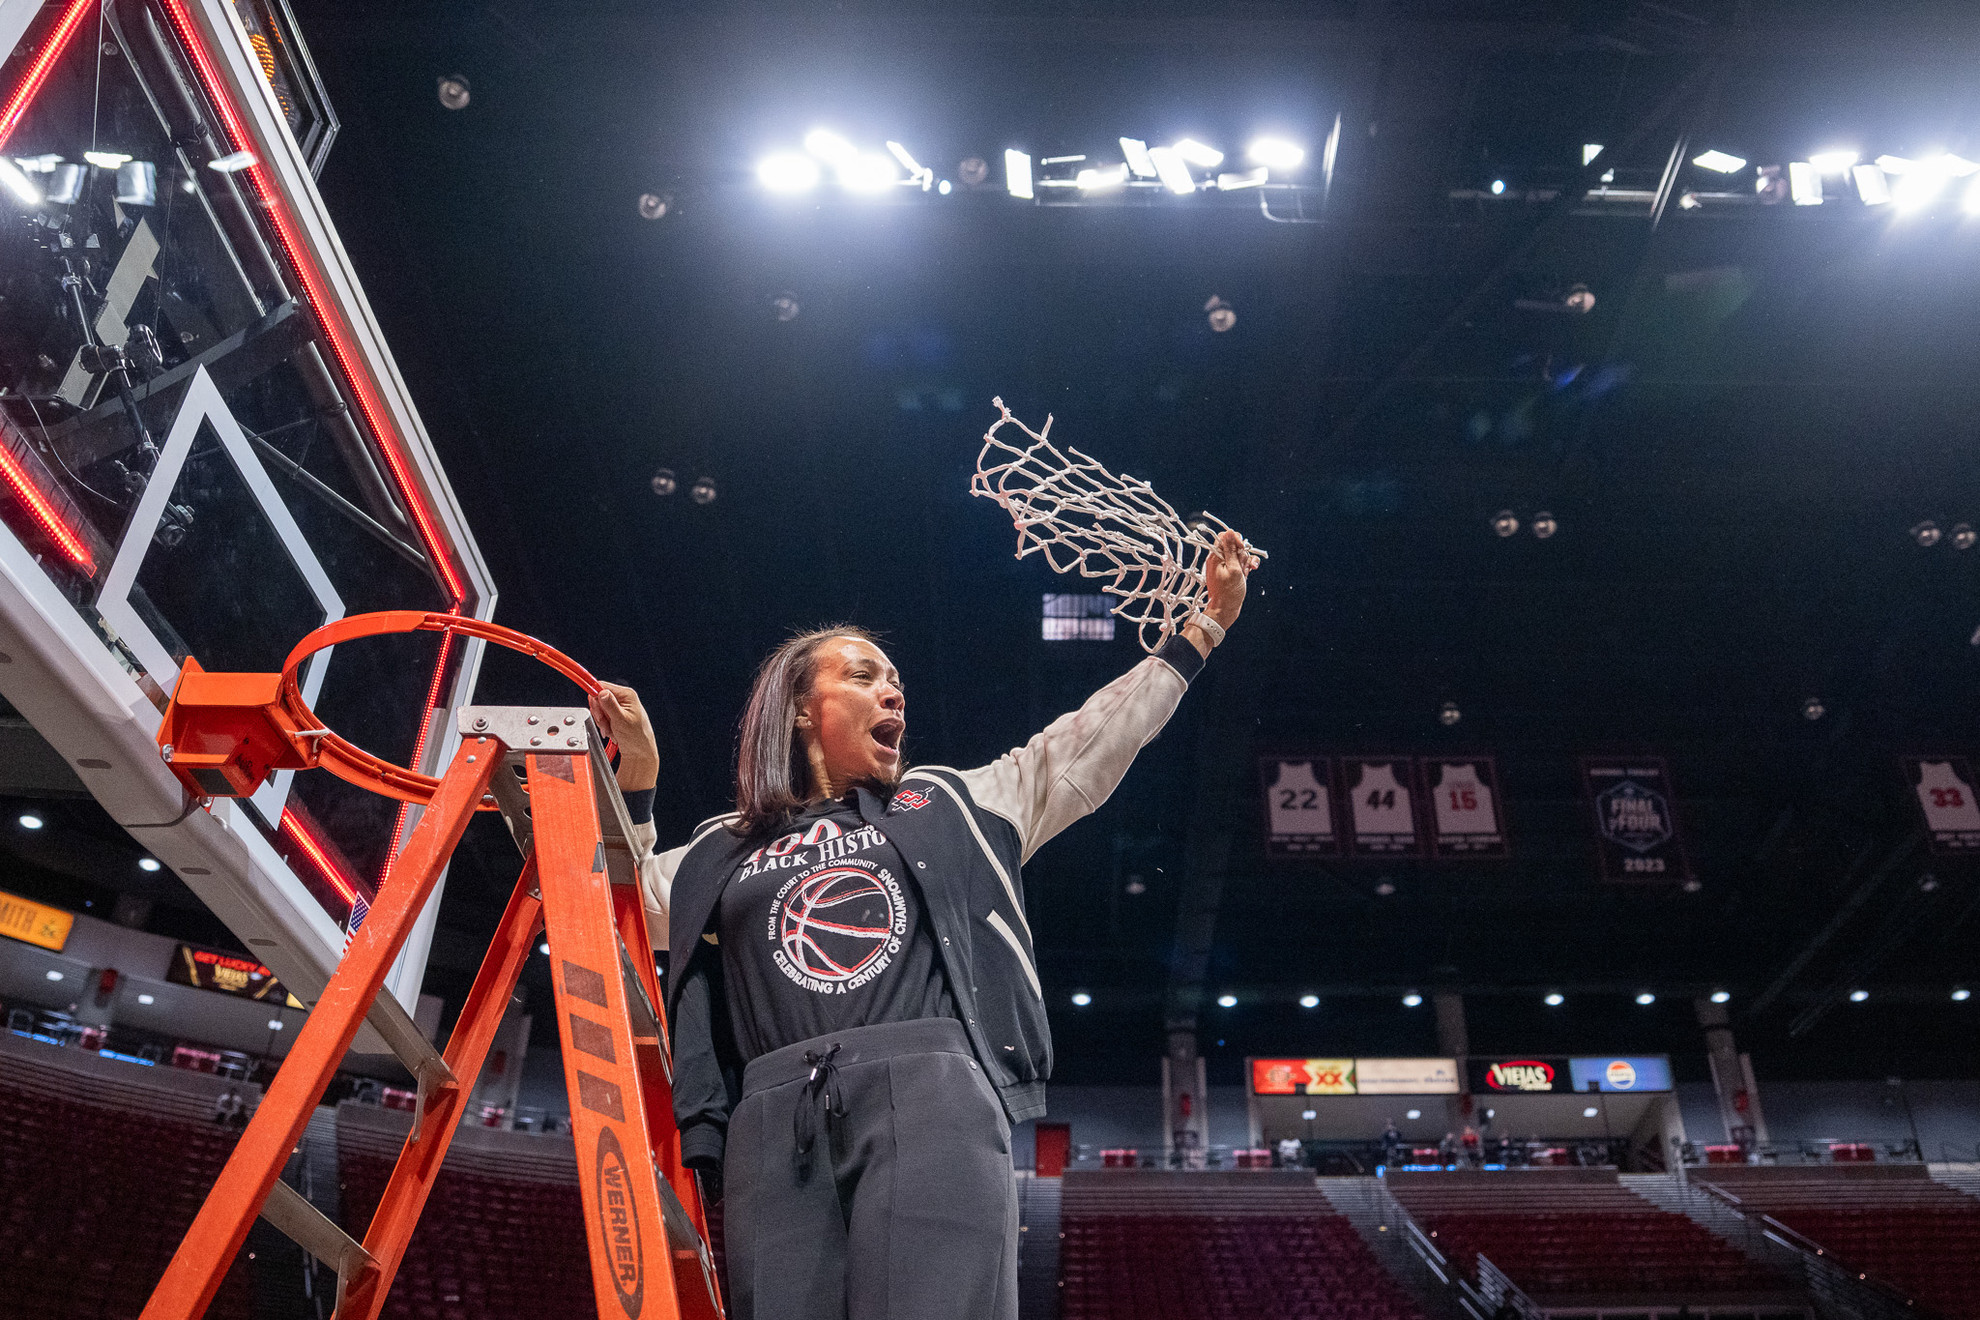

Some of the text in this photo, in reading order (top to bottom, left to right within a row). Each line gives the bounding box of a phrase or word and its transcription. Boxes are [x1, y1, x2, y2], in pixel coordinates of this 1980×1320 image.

[1279, 788, 1318, 811] 22
[1366, 789, 1396, 811] 44
[1611, 799, 1655, 815] FINAL
[1930, 787, 1964, 808] 33
[738, 850, 809, 884] BLACK
[1624, 859, 1665, 872] 2023
[768, 858, 878, 941] FROM THE COURT TO THE COMMUNITY
[772, 868, 907, 995] CELEBRATING A CENTURY OF CHAMPIONS
[1315, 1070, 1344, 1087] XX
[604, 1165, 637, 1282] WERNER
